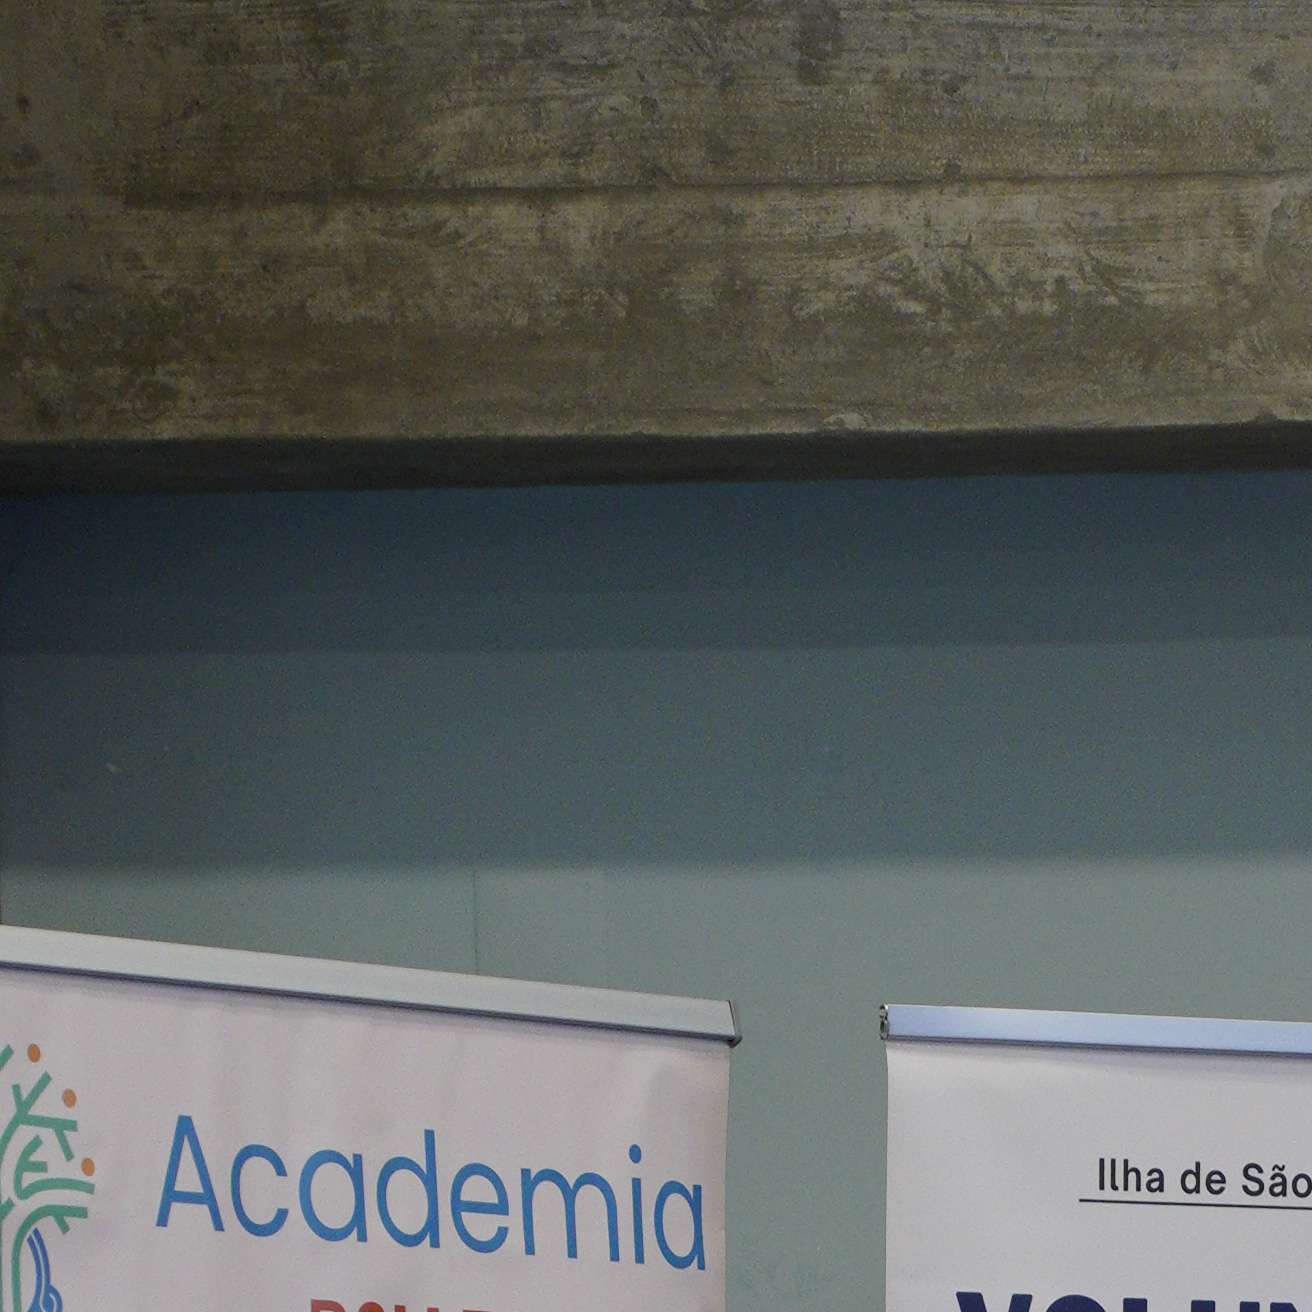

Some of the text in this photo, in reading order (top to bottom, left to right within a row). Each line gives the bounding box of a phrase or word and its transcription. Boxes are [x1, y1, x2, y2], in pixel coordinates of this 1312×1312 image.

[156, 1114, 706, 1271] Academia
[1098, 1157, 1165, 1193] Ilha
[1180, 1161, 1227, 1195] de
[1242, 1163, 1312, 1199] São
